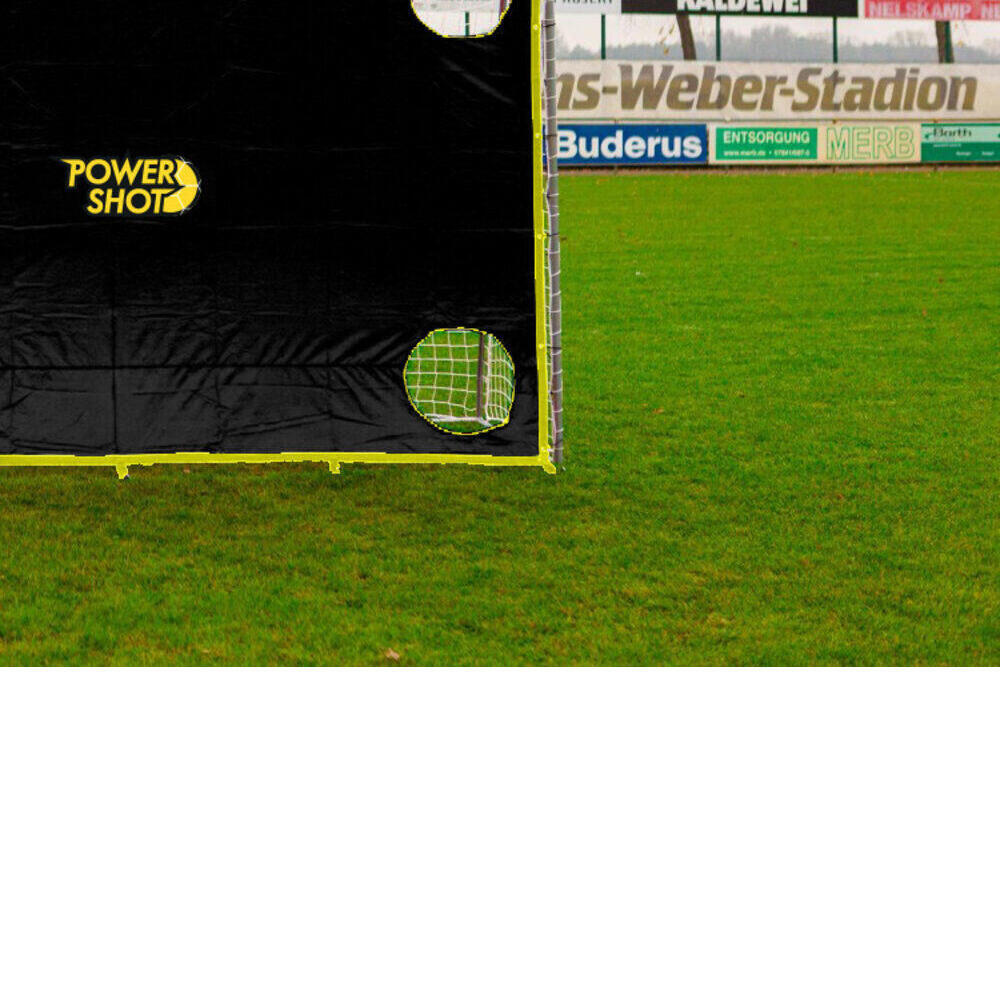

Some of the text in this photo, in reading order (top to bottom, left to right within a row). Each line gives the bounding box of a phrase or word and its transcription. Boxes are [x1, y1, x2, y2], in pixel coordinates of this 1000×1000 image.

[868, 0, 973, 18] NELSKAMP
[557, 129, 703, 159] Buderus
[723, 130, 810, 144] ENTSORGUNG
[825, 125, 916, 161] MERB
[60, 157, 176, 188] POWER
[86, 187, 176, 215] SHOT
